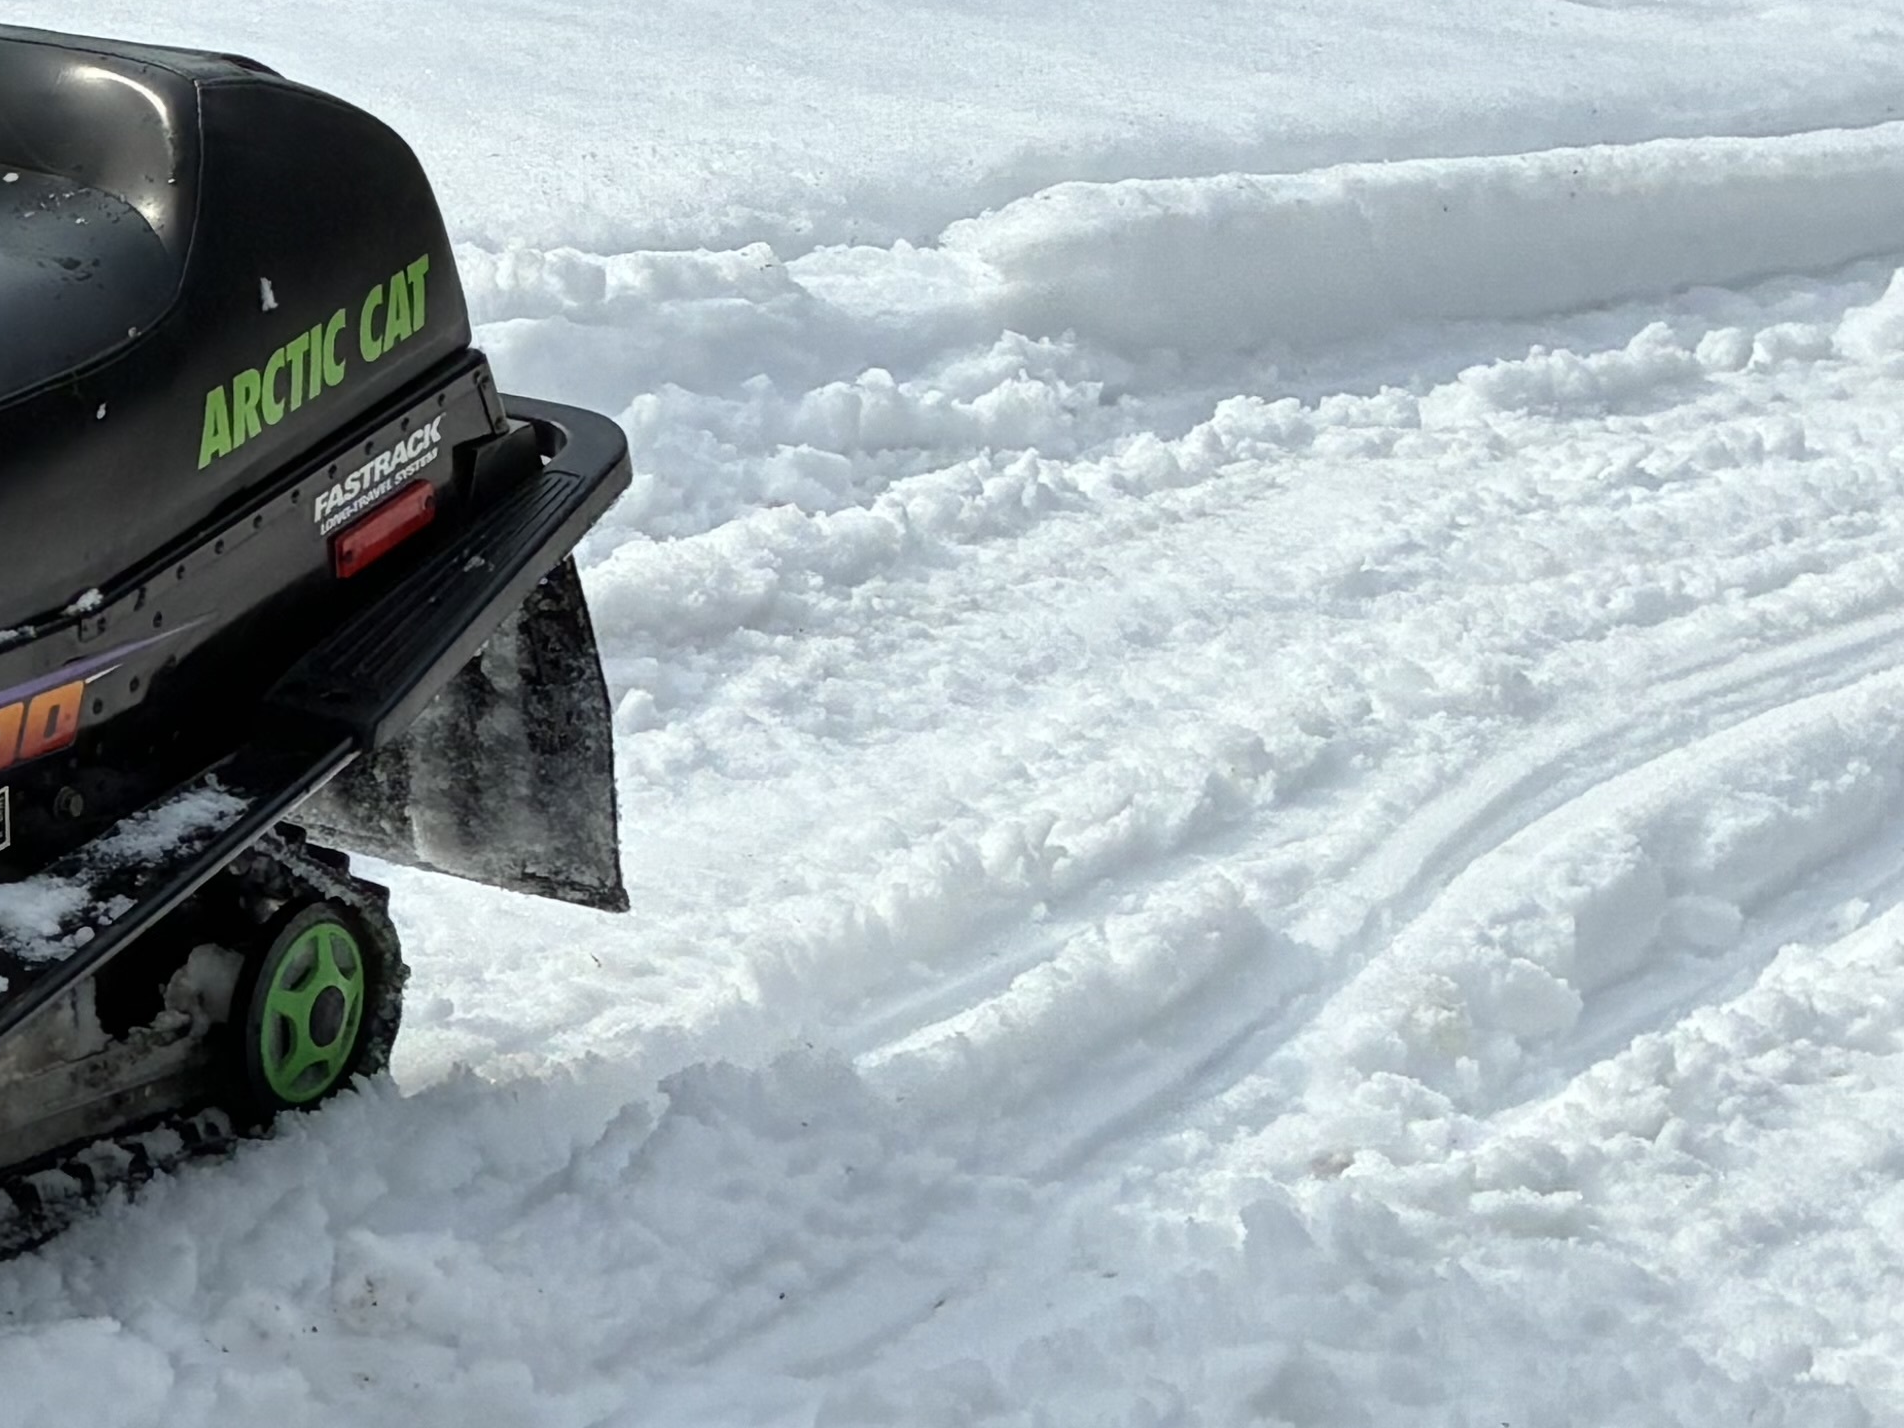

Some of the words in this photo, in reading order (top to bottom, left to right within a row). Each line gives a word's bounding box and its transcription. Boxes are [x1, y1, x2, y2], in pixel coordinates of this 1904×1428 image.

[198, 308, 346, 470] ARCTIC
[359, 253, 429, 362] CAT
[314, 415, 441, 523] FASTRACK
